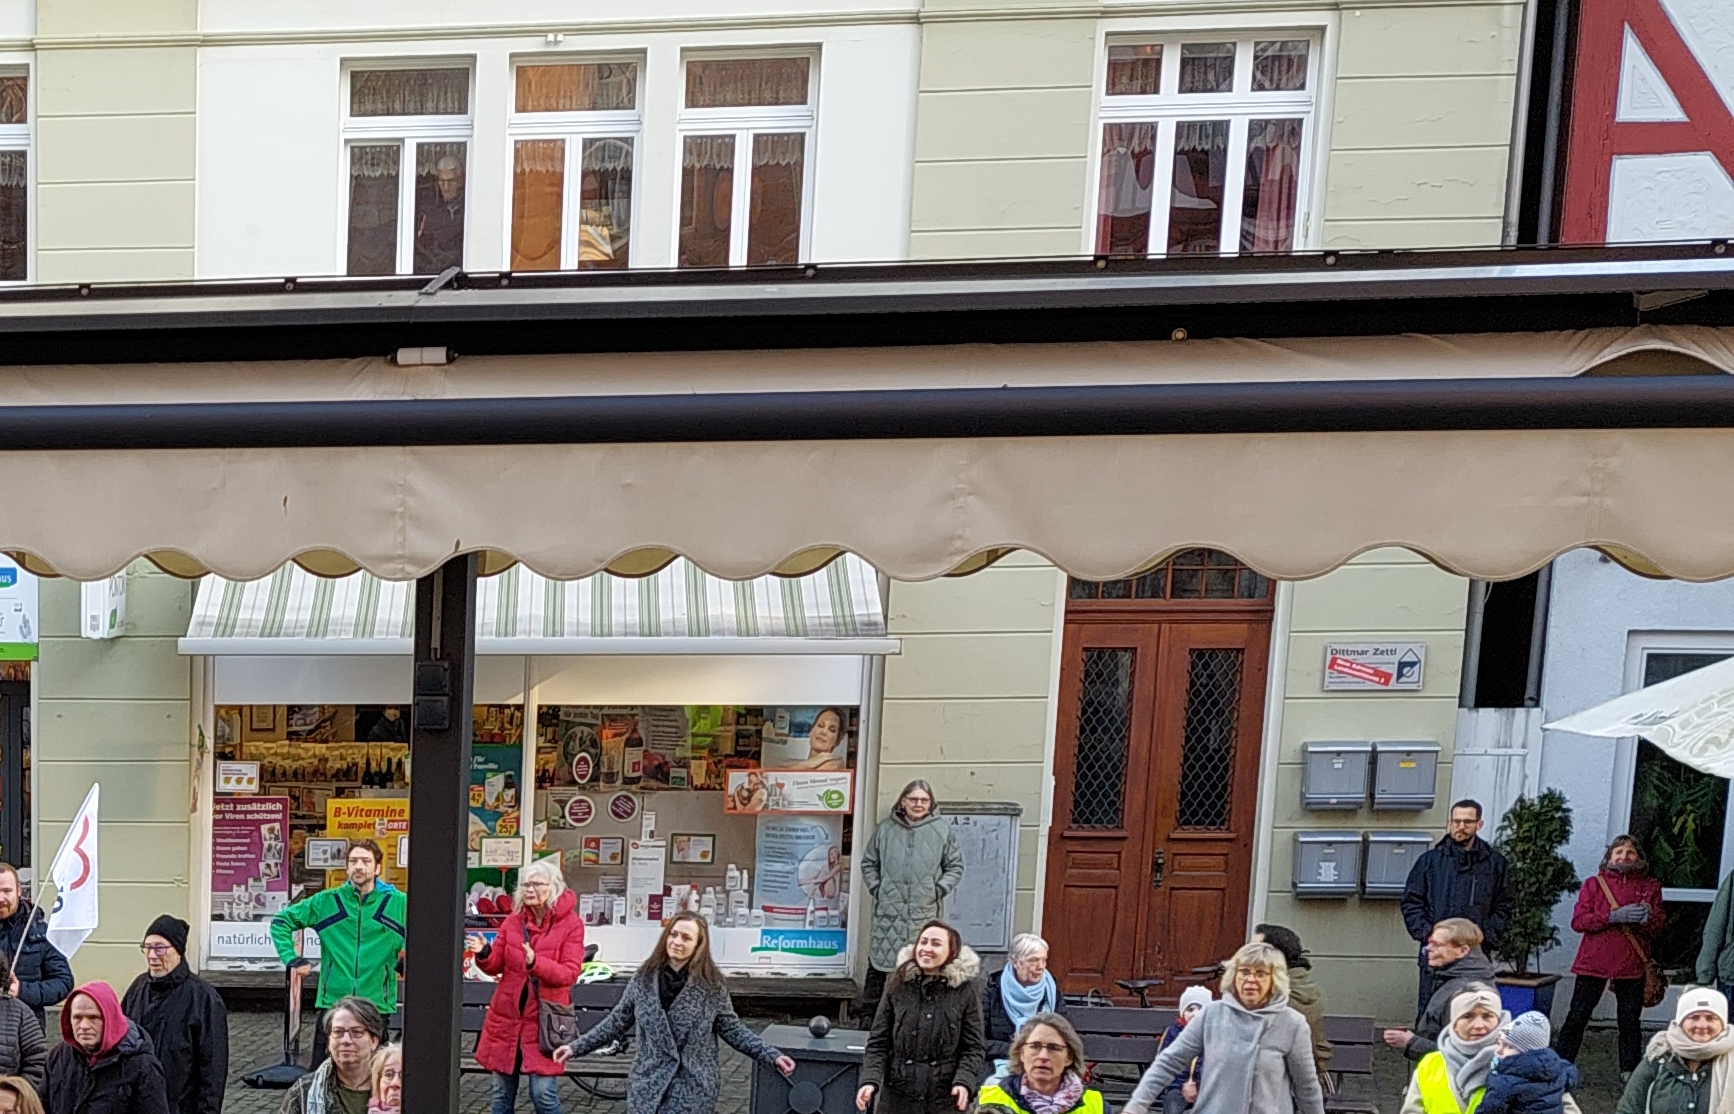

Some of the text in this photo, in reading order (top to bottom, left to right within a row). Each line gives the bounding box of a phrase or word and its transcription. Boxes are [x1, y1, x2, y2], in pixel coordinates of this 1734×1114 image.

[1330, 647, 1370, 656] Dittmar
[236, 802, 283, 811] zusätzlich
[333, 805, 406, 818] B-Vitamine
[225, 812, 245, 820] Viren
[246, 812, 283, 820] schützen!
[337, 820, 376, 831] komplet
[386, 820, 408, 830] ORTE
[217, 933, 271, 946] natürlich
[762, 935, 839, 953] Reformhaus
